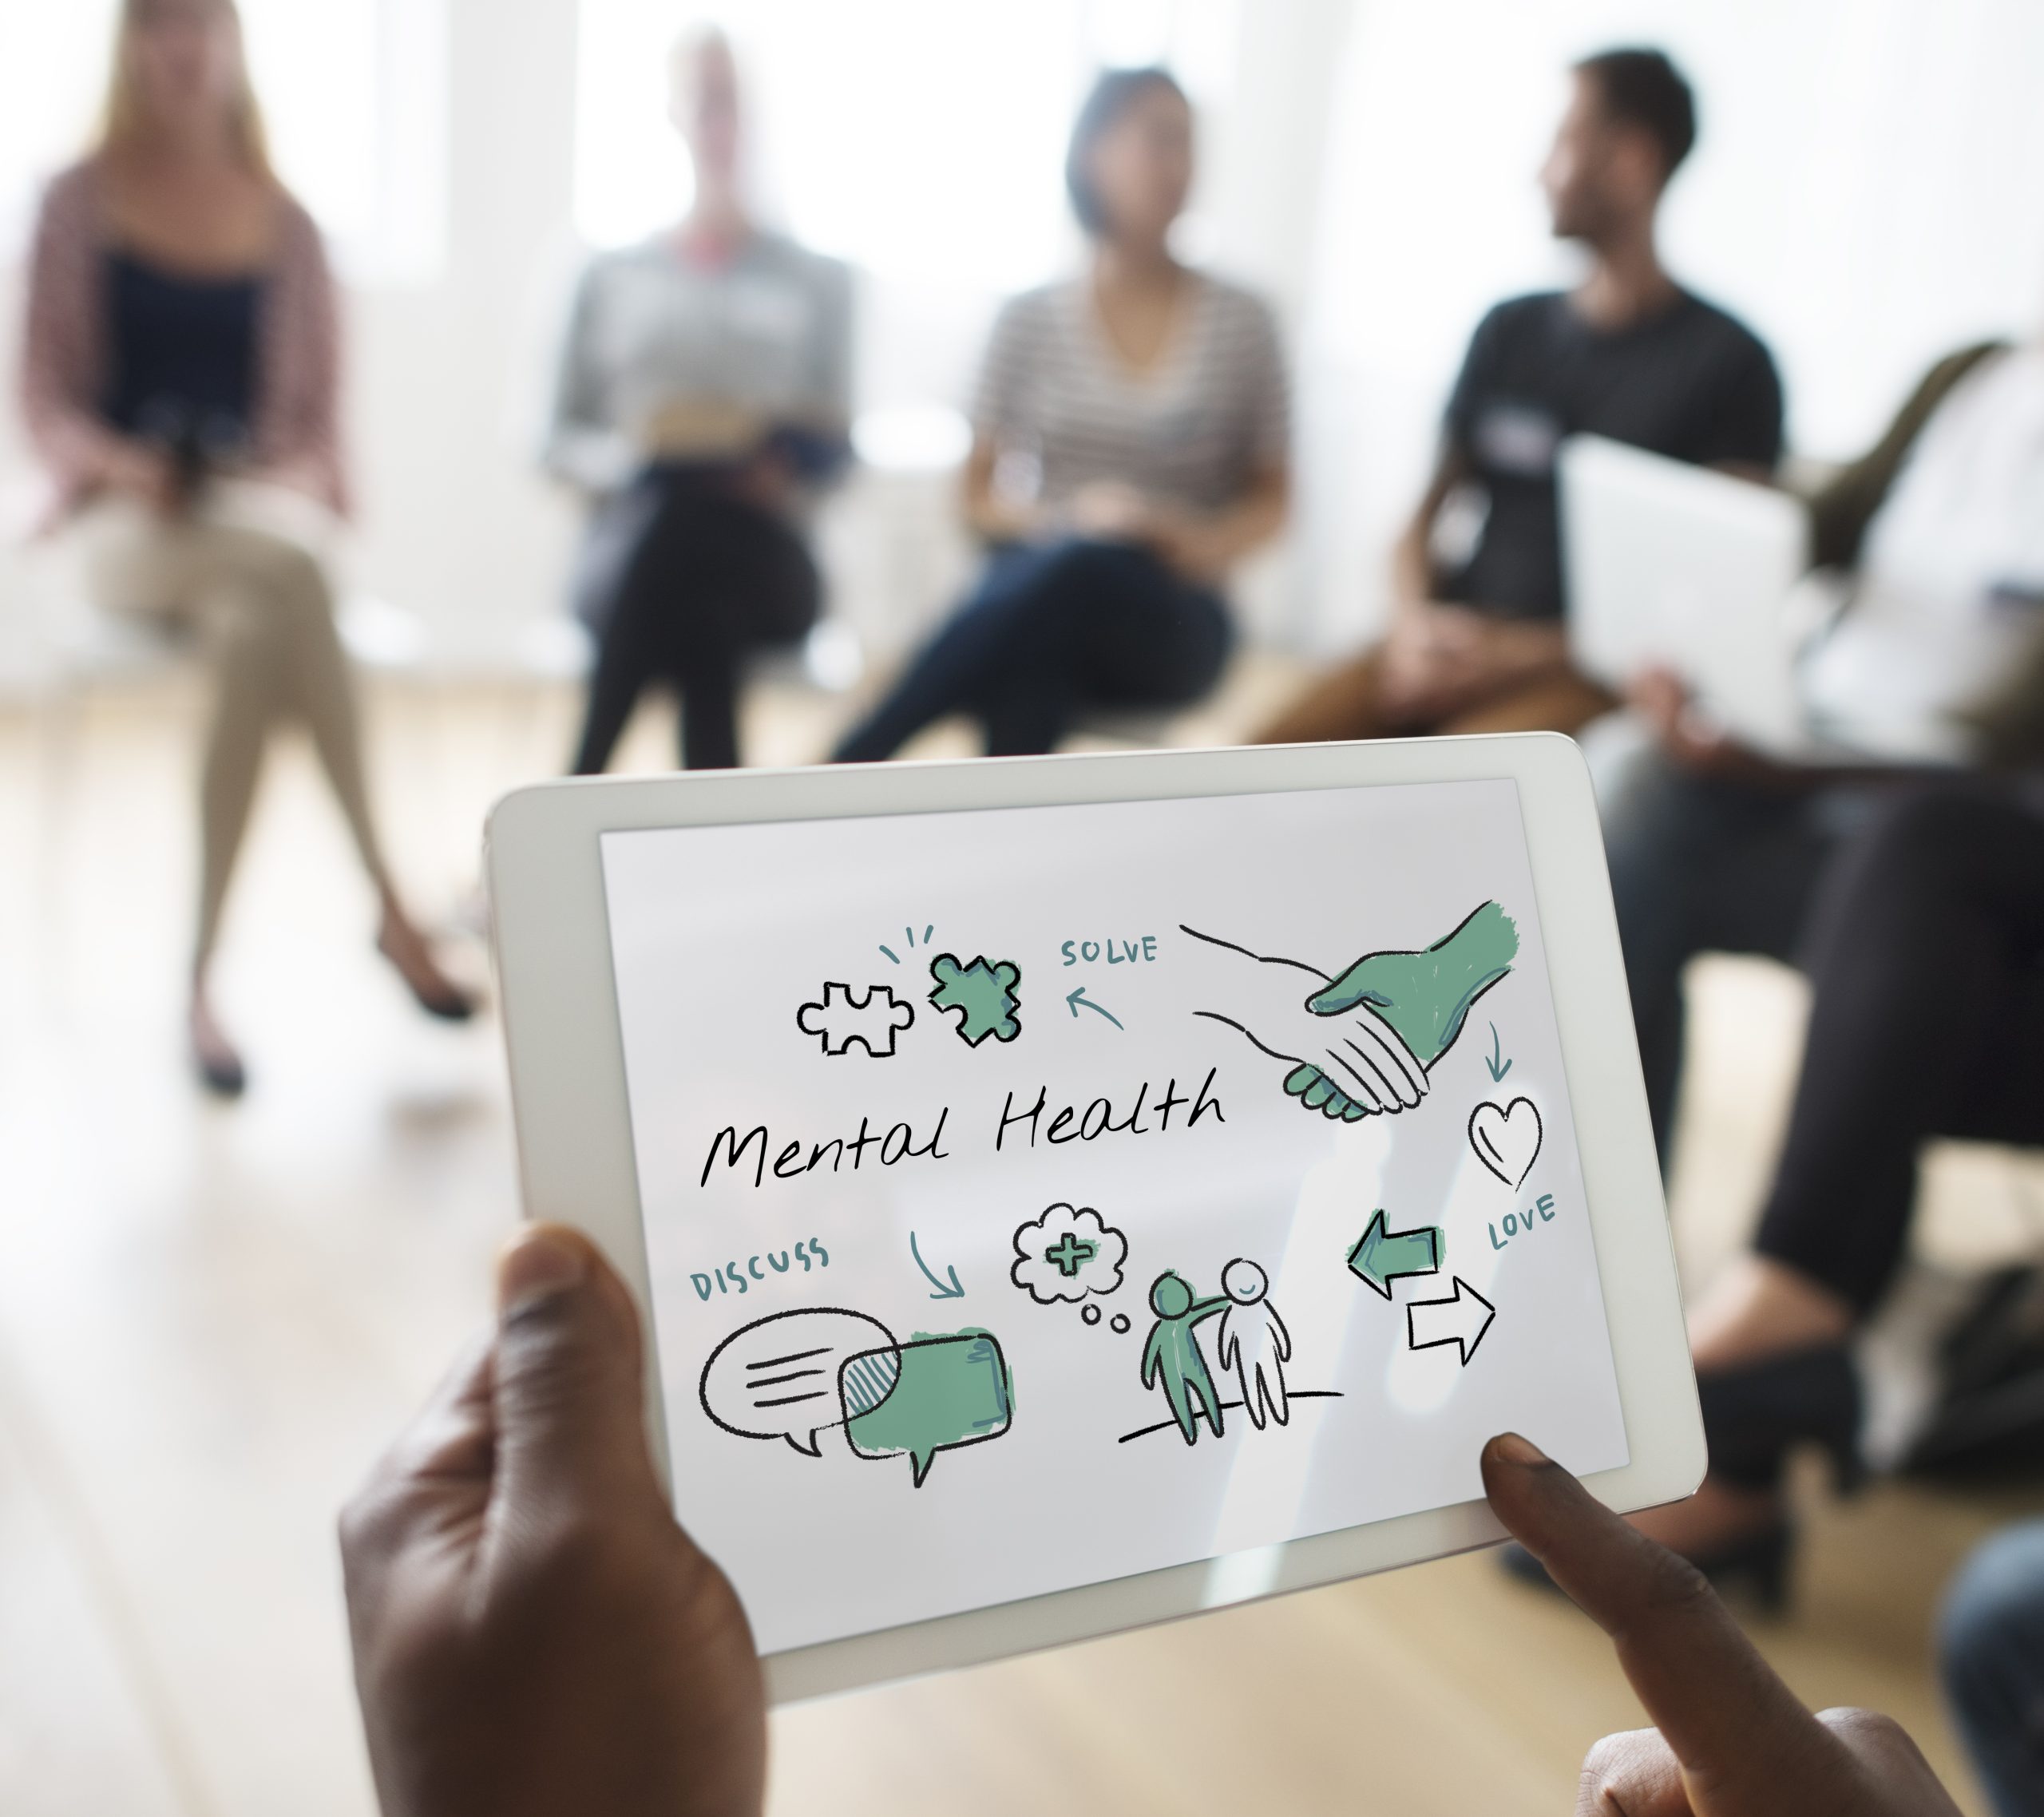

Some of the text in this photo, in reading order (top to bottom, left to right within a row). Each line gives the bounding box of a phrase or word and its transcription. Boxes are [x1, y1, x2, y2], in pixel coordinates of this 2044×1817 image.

[1061, 936, 1158, 967] SOLVE
[700, 1066, 1226, 1188] Mental Health
[1487, 1194, 1555, 1250] LOVE
[689, 1237, 830, 1303] DISCUSS
